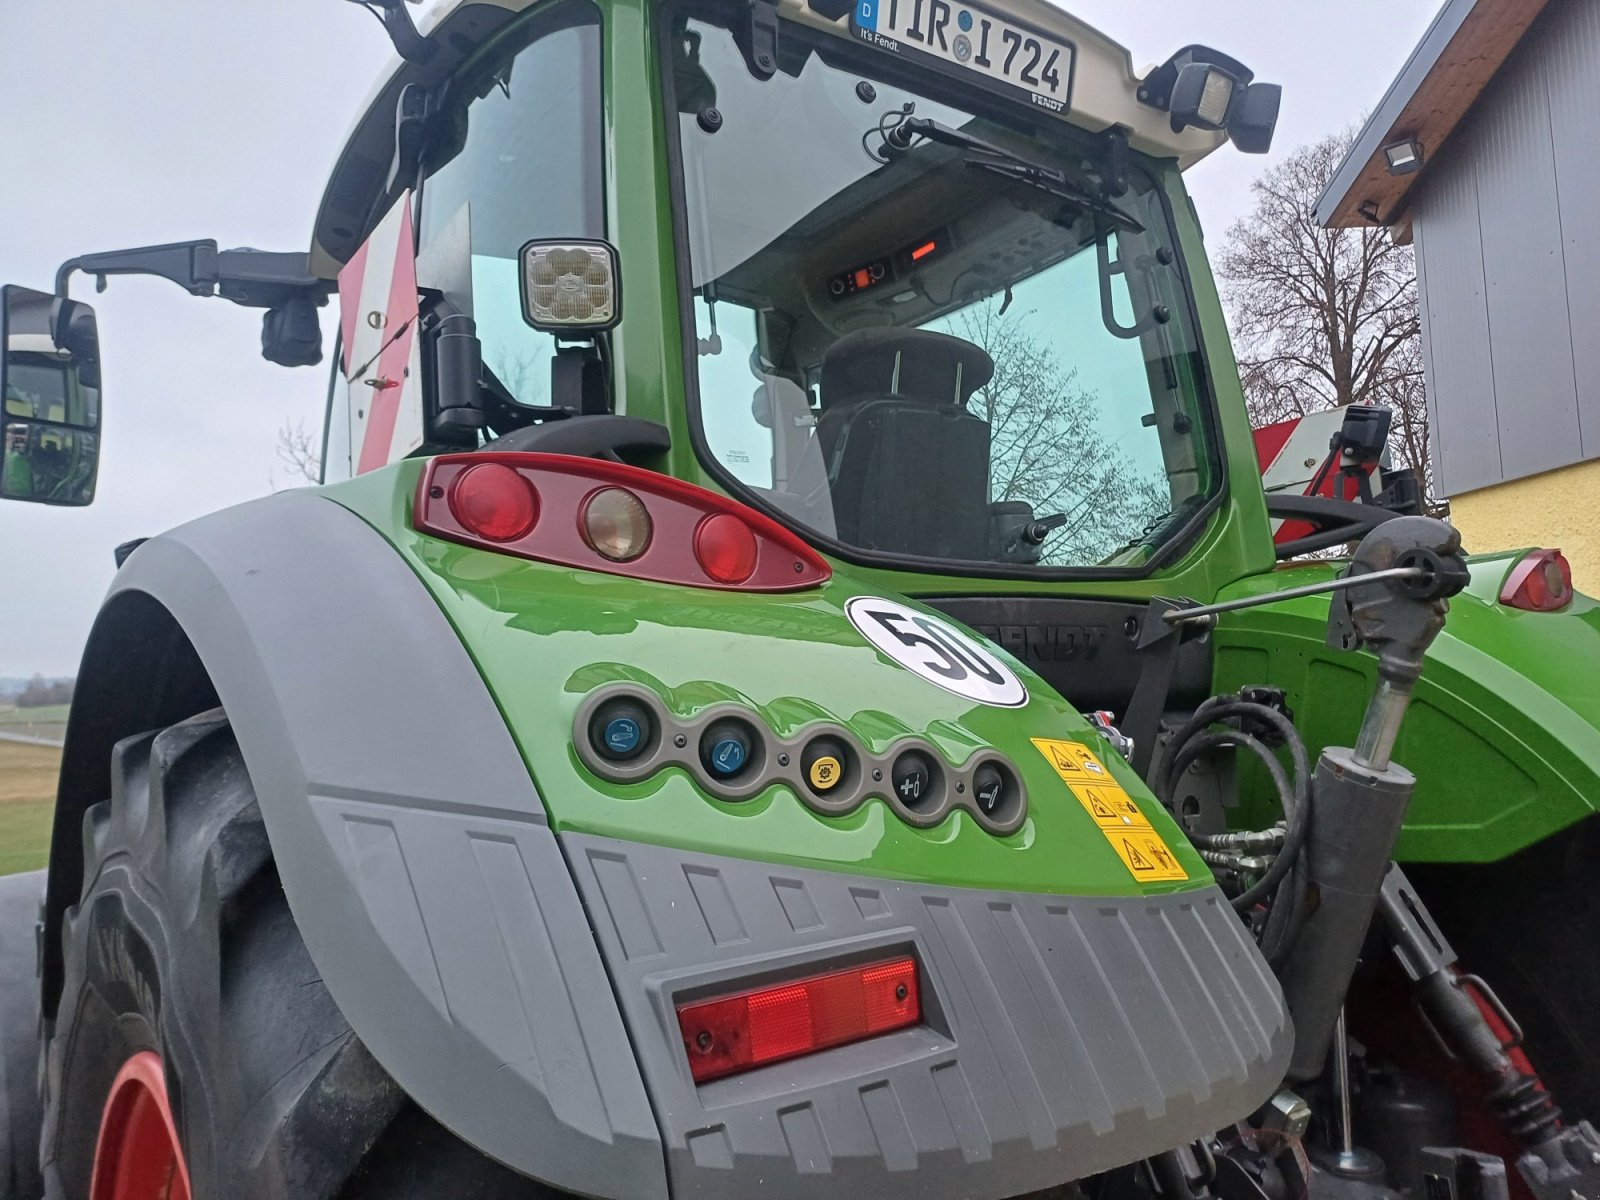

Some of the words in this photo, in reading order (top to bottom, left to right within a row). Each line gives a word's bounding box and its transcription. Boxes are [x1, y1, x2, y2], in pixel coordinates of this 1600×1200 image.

[862, 3, 871, 18] D
[860, 28, 873, 42] It's
[874, 33, 900, 53] Fendt.
[974, 18, 991, 69] I
[1003, 28, 1060, 93] 724
[1031, 92, 1064, 112] FENDT
[864, 609, 1006, 686] 50
